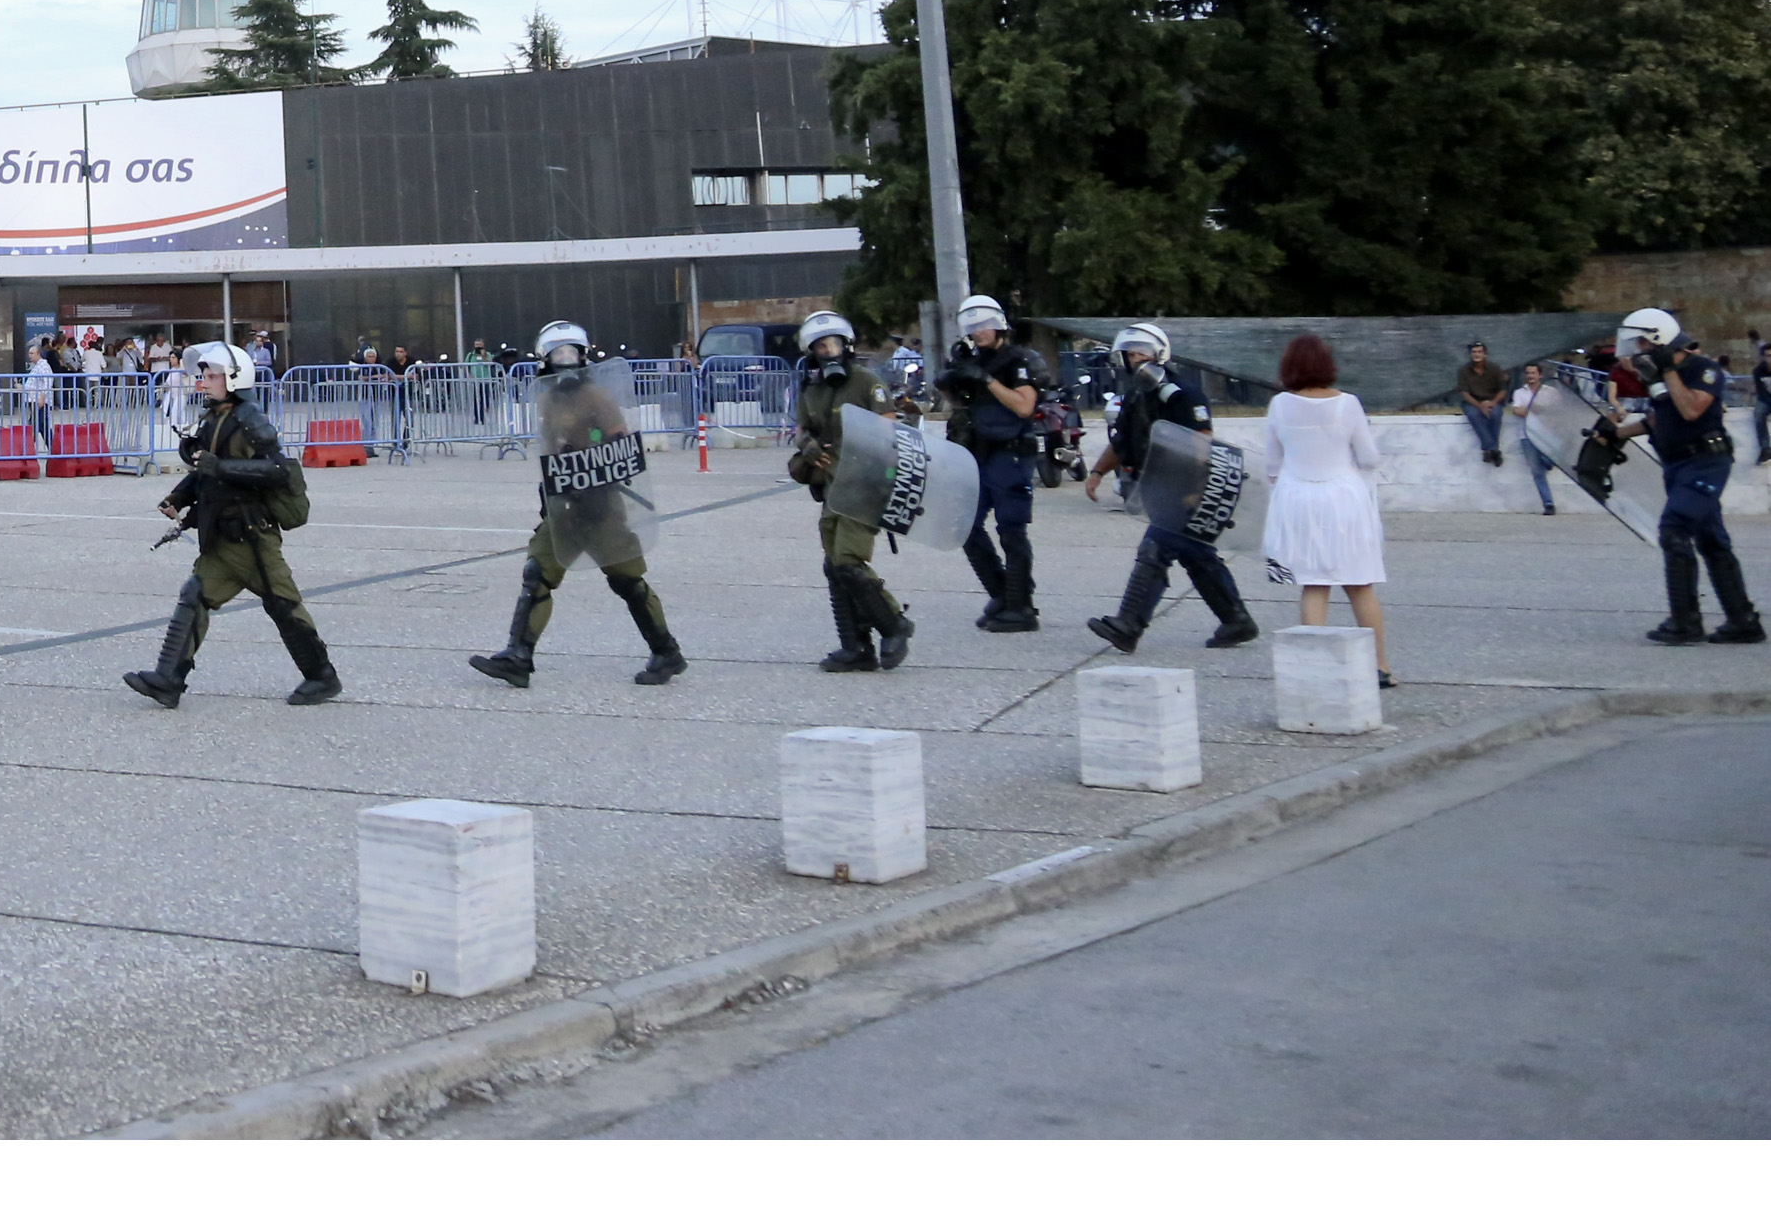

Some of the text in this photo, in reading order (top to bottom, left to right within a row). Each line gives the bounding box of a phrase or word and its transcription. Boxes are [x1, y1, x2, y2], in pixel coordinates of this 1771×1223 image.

[125, 156, 194, 183] σας
[547, 434, 641, 477] ΑΣΤΥΝΟΜΙΑ
[554, 456, 640, 494] POLICE
[882, 429, 913, 526] ΑΣΤΥΝΟΜΙΑ
[897, 436, 927, 526] POLICE
[1204, 453, 1243, 535] POLICE
